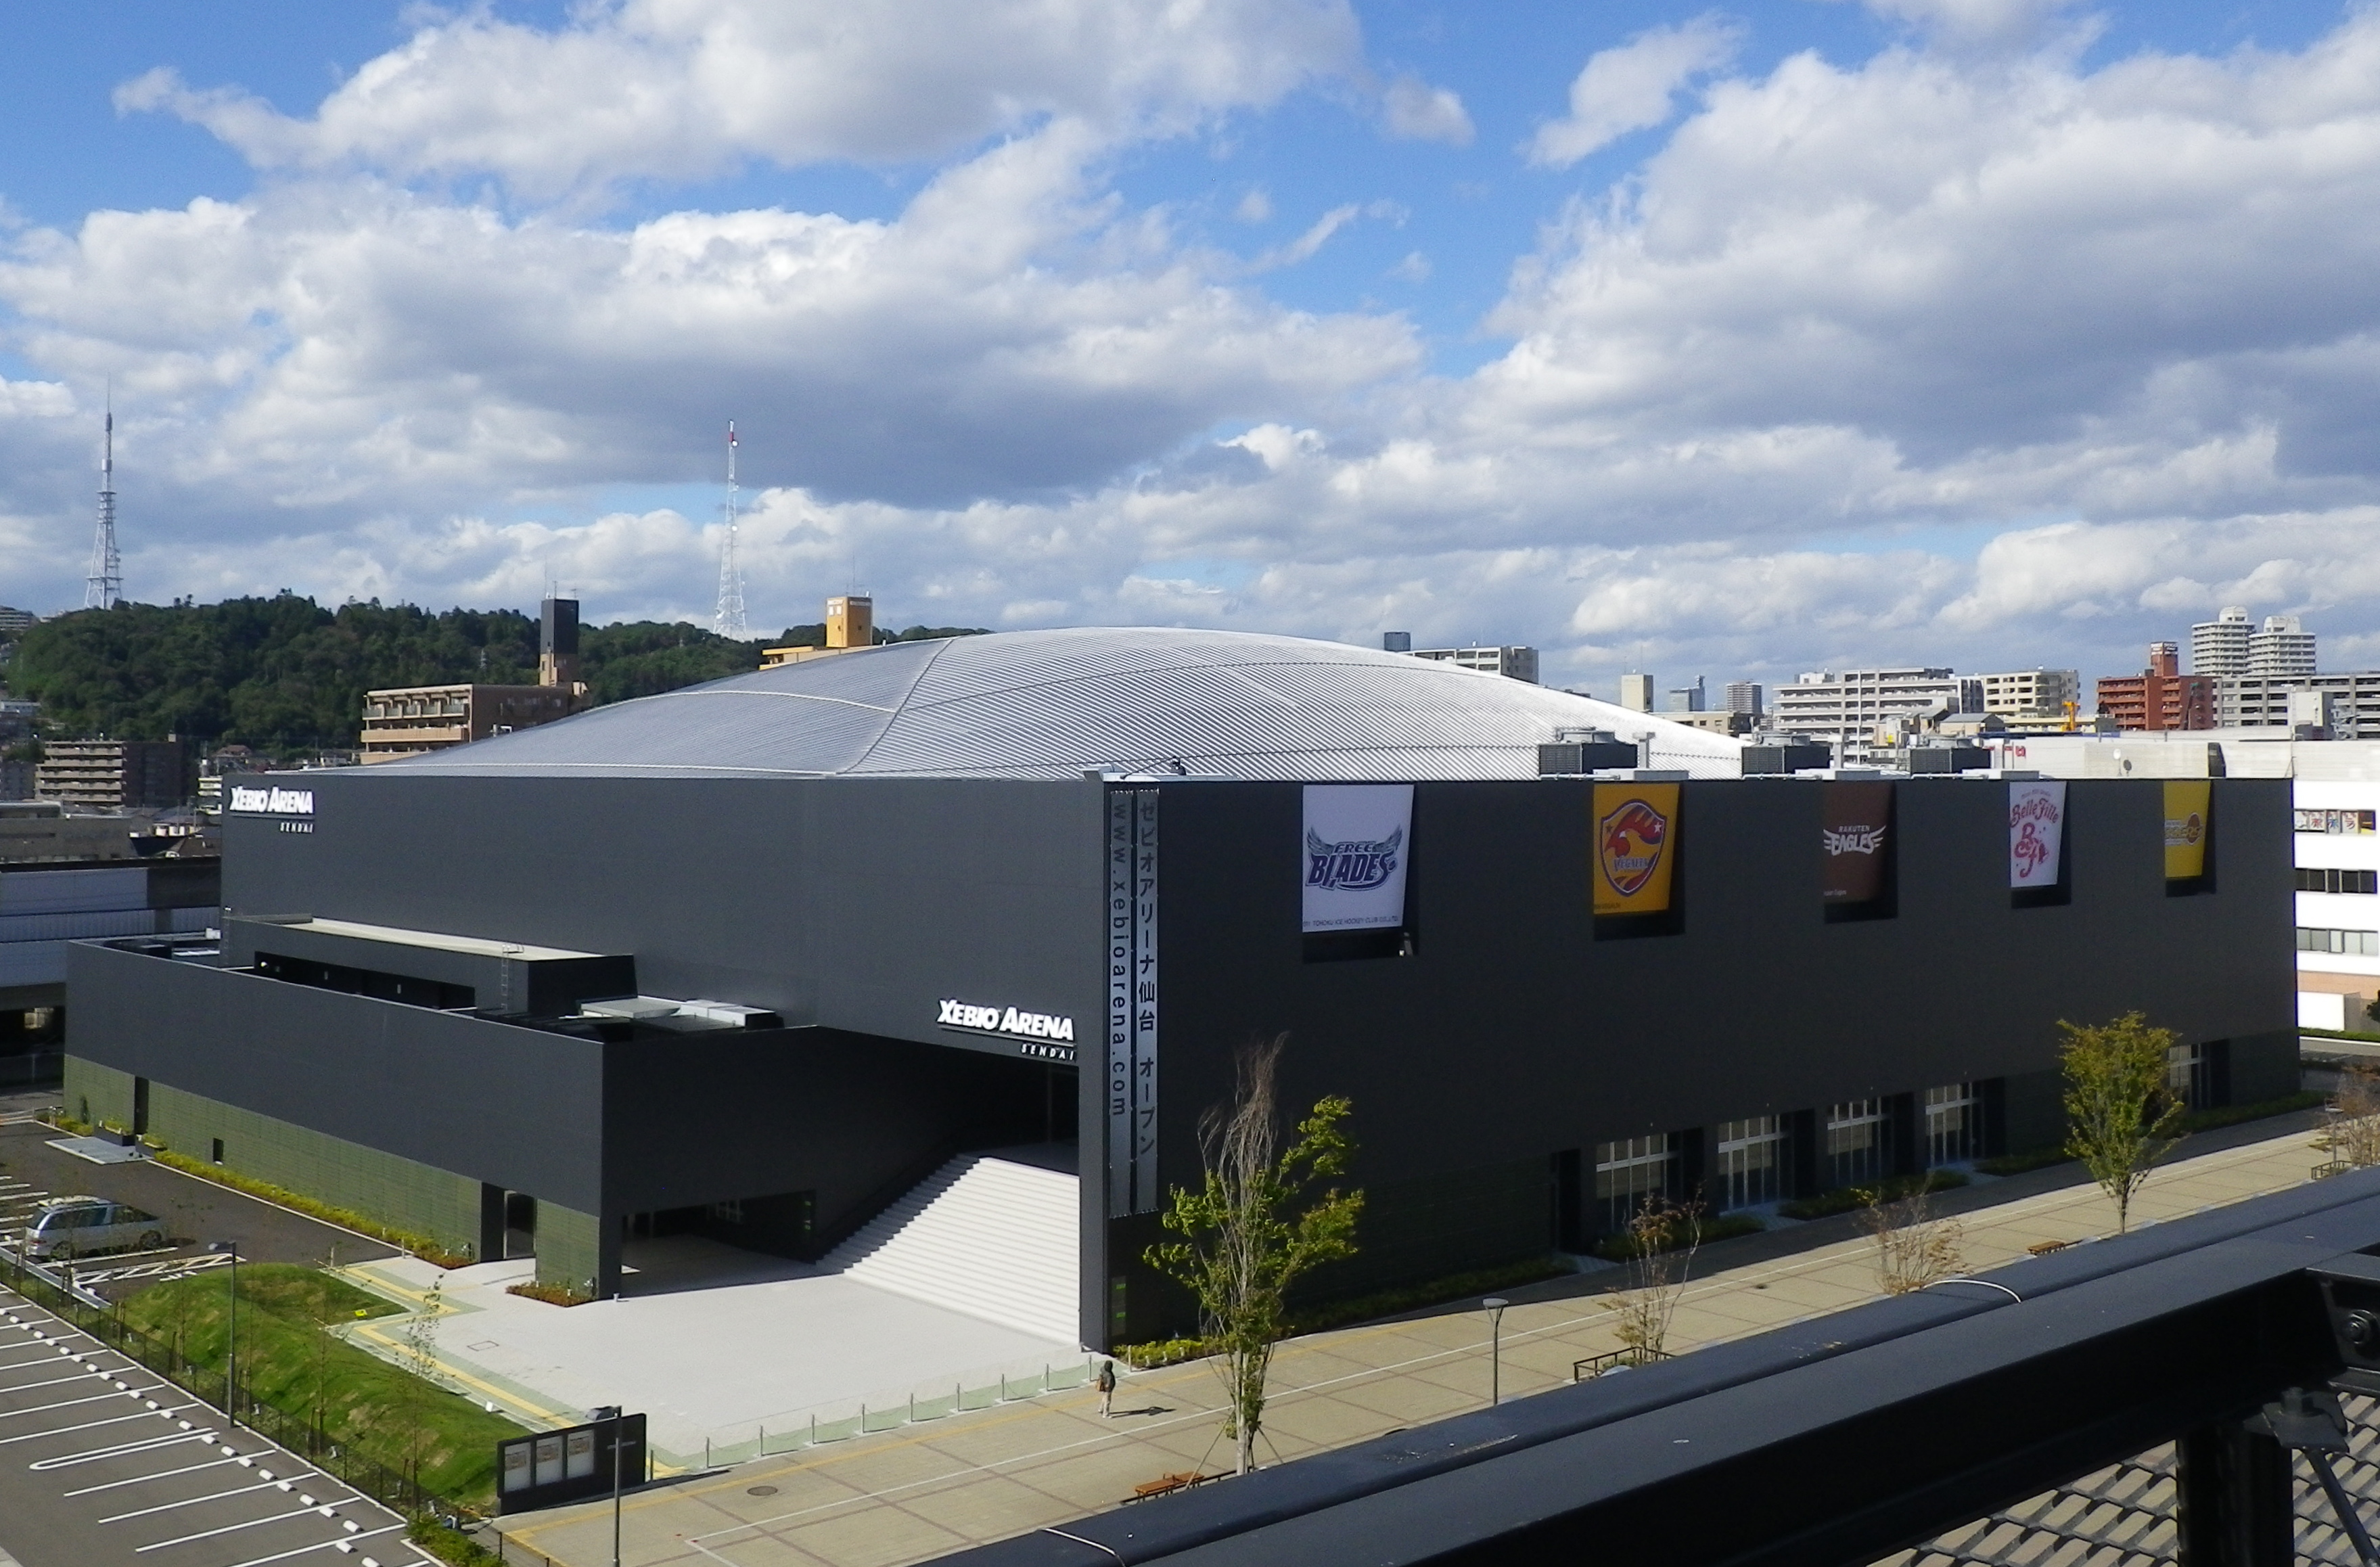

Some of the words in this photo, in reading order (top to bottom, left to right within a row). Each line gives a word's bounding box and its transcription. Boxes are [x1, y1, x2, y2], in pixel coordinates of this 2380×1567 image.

[229, 786, 269, 813] XEBIO
[267, 786, 314, 814] ARENA
[2010, 799, 2038, 828] Belle
[2035, 797, 2059, 823] Fille
[280, 822, 313, 834] SENDAI
[1838, 825, 1871, 833] RAKUTEN
[1333, 842, 1375, 853] FREE
[1825, 831, 1881, 856] EAGLES
[1308, 850, 1395, 888] BLADES
[1112, 803, 1129, 1116] www.xebioarena.com
[937, 999, 1000, 1030] XEBIO
[999, 1007, 1074, 1041] ARENA
[1022, 1043, 1074, 1061] SENDAI
